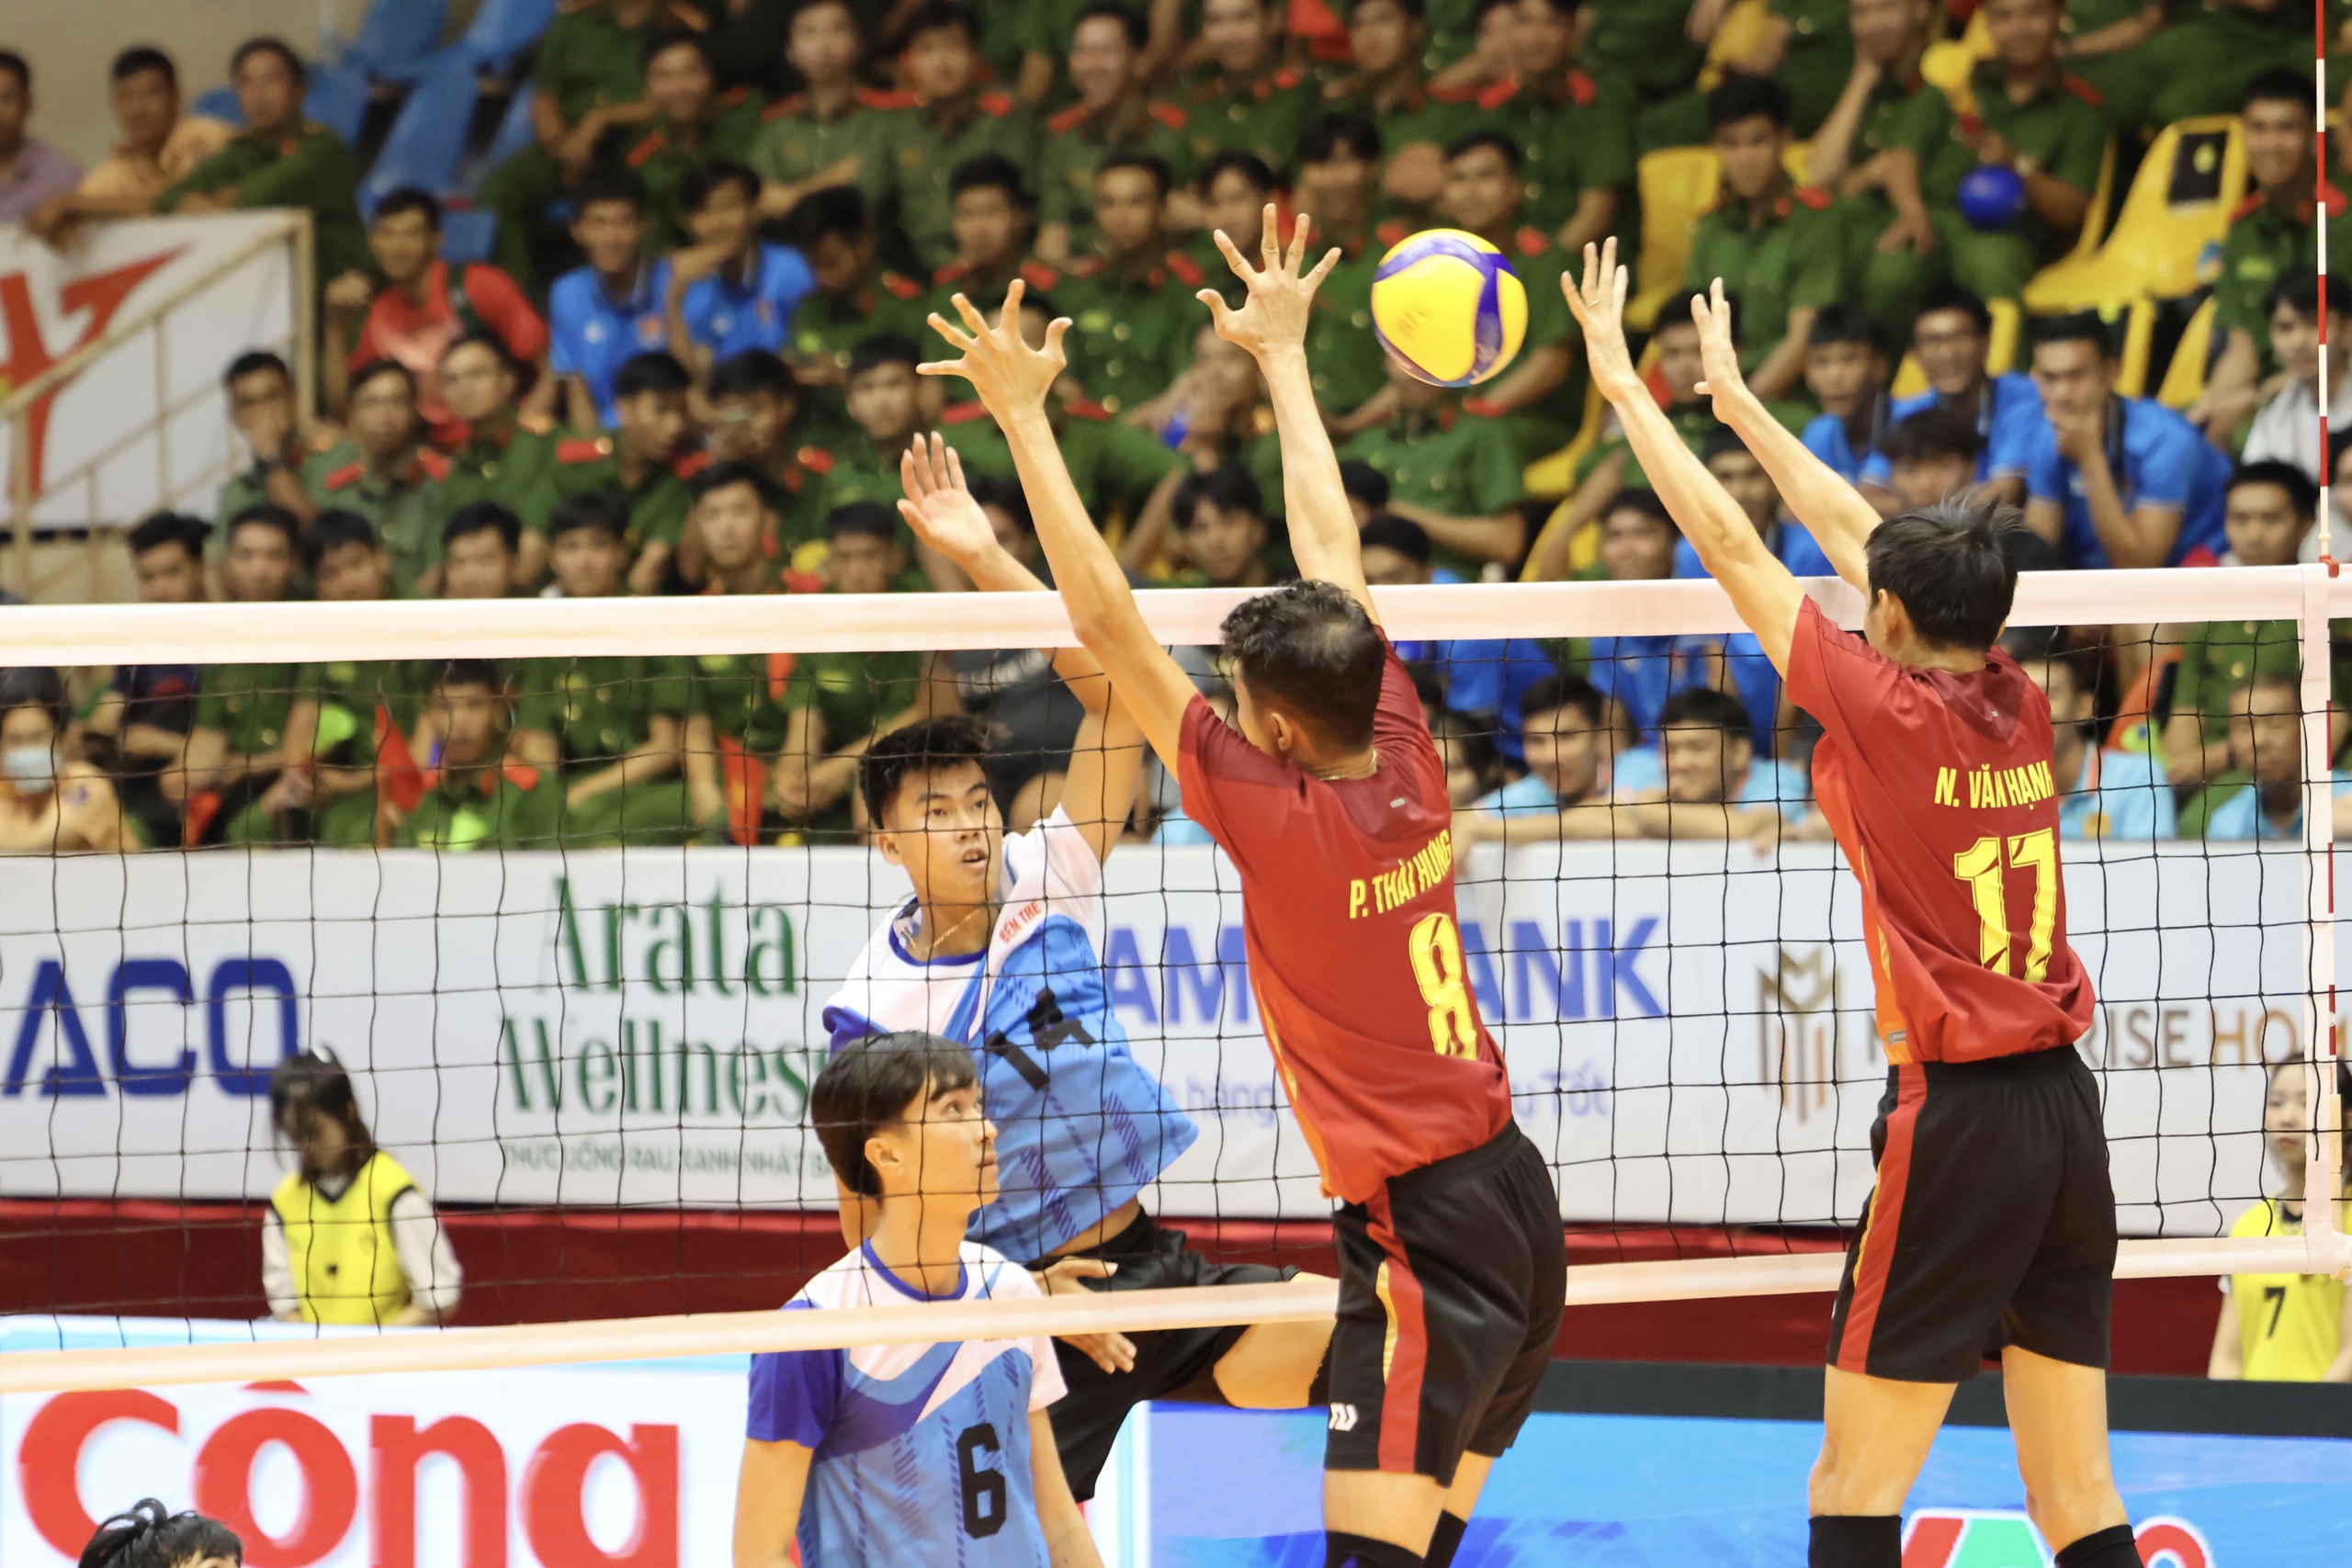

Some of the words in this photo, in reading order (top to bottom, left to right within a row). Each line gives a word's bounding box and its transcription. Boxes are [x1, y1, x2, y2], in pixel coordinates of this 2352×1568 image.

[1934, 766, 1960, 807] N.
[537, 874, 797, 996] Arata
[1350, 879, 1369, 919] P.
[1953, 827, 2057, 984] 17
[1104, 927, 1249, 1023] AM
[1459, 917, 1665, 1021] ANK
[1408, 912, 1477, 1062] 8
[503, 1015, 832, 1120] Wellnes
[2263, 1286, 2287, 1340] 7
[956, 1423, 1006, 1540] 6
